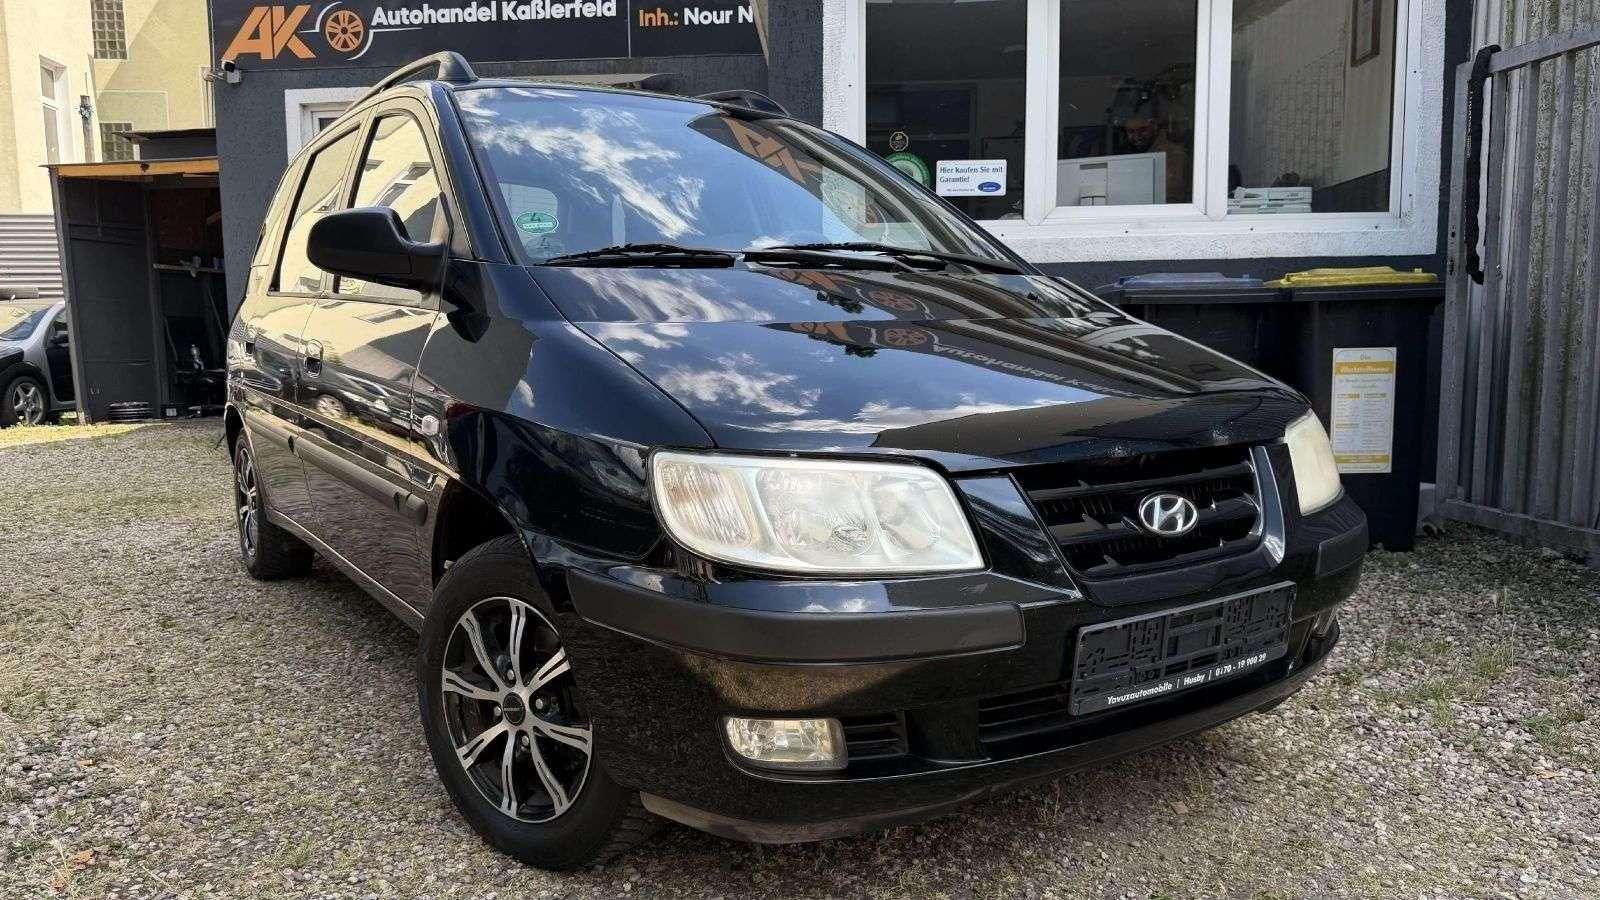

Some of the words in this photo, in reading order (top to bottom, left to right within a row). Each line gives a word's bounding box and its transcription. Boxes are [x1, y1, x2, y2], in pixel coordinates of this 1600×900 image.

[371, 1, 497, 26] Autohandel
[502, 0, 617, 21] Kaßlerfeld
[639, 8, 679, 27] Inh.:
[683, 7, 734, 26] Nour
[221, 5, 317, 60] AK
[939, 166, 954, 174] Hier
[979, 166, 990, 174] Sie
[991, 166, 1003, 174] mit
[1183, 673, 1206, 686] Husby
